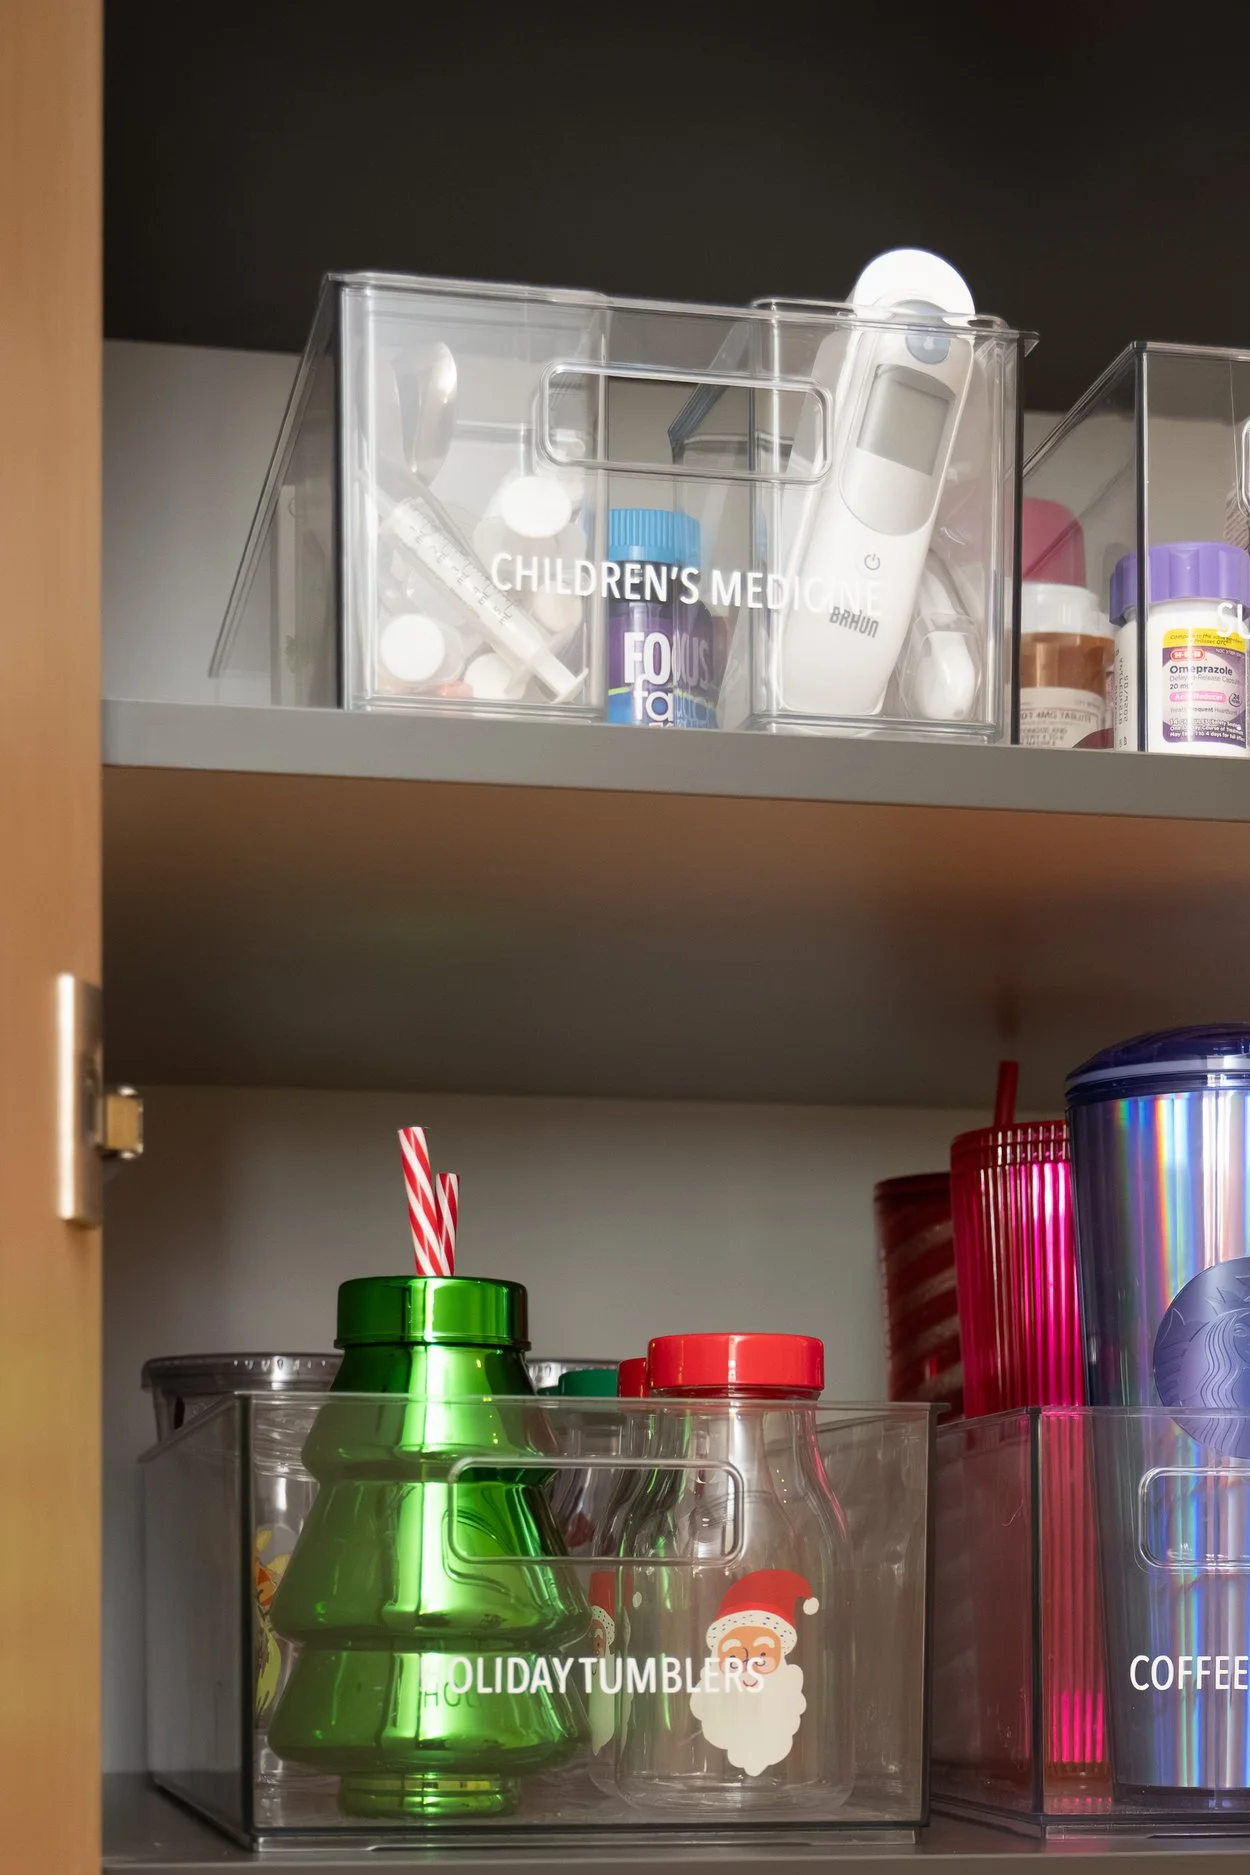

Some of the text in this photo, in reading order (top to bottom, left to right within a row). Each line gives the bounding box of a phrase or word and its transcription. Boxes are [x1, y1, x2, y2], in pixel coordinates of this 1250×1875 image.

[489, 552, 882, 616] CHILDREN'S MEDICINE
[829, 607, 880, 639] BRAUN
[1170, 665, 1233, 676] Omeprazole
[579, 1656, 766, 1694] TUMBLERS
[1129, 1654, 1249, 1691] COFFEE
